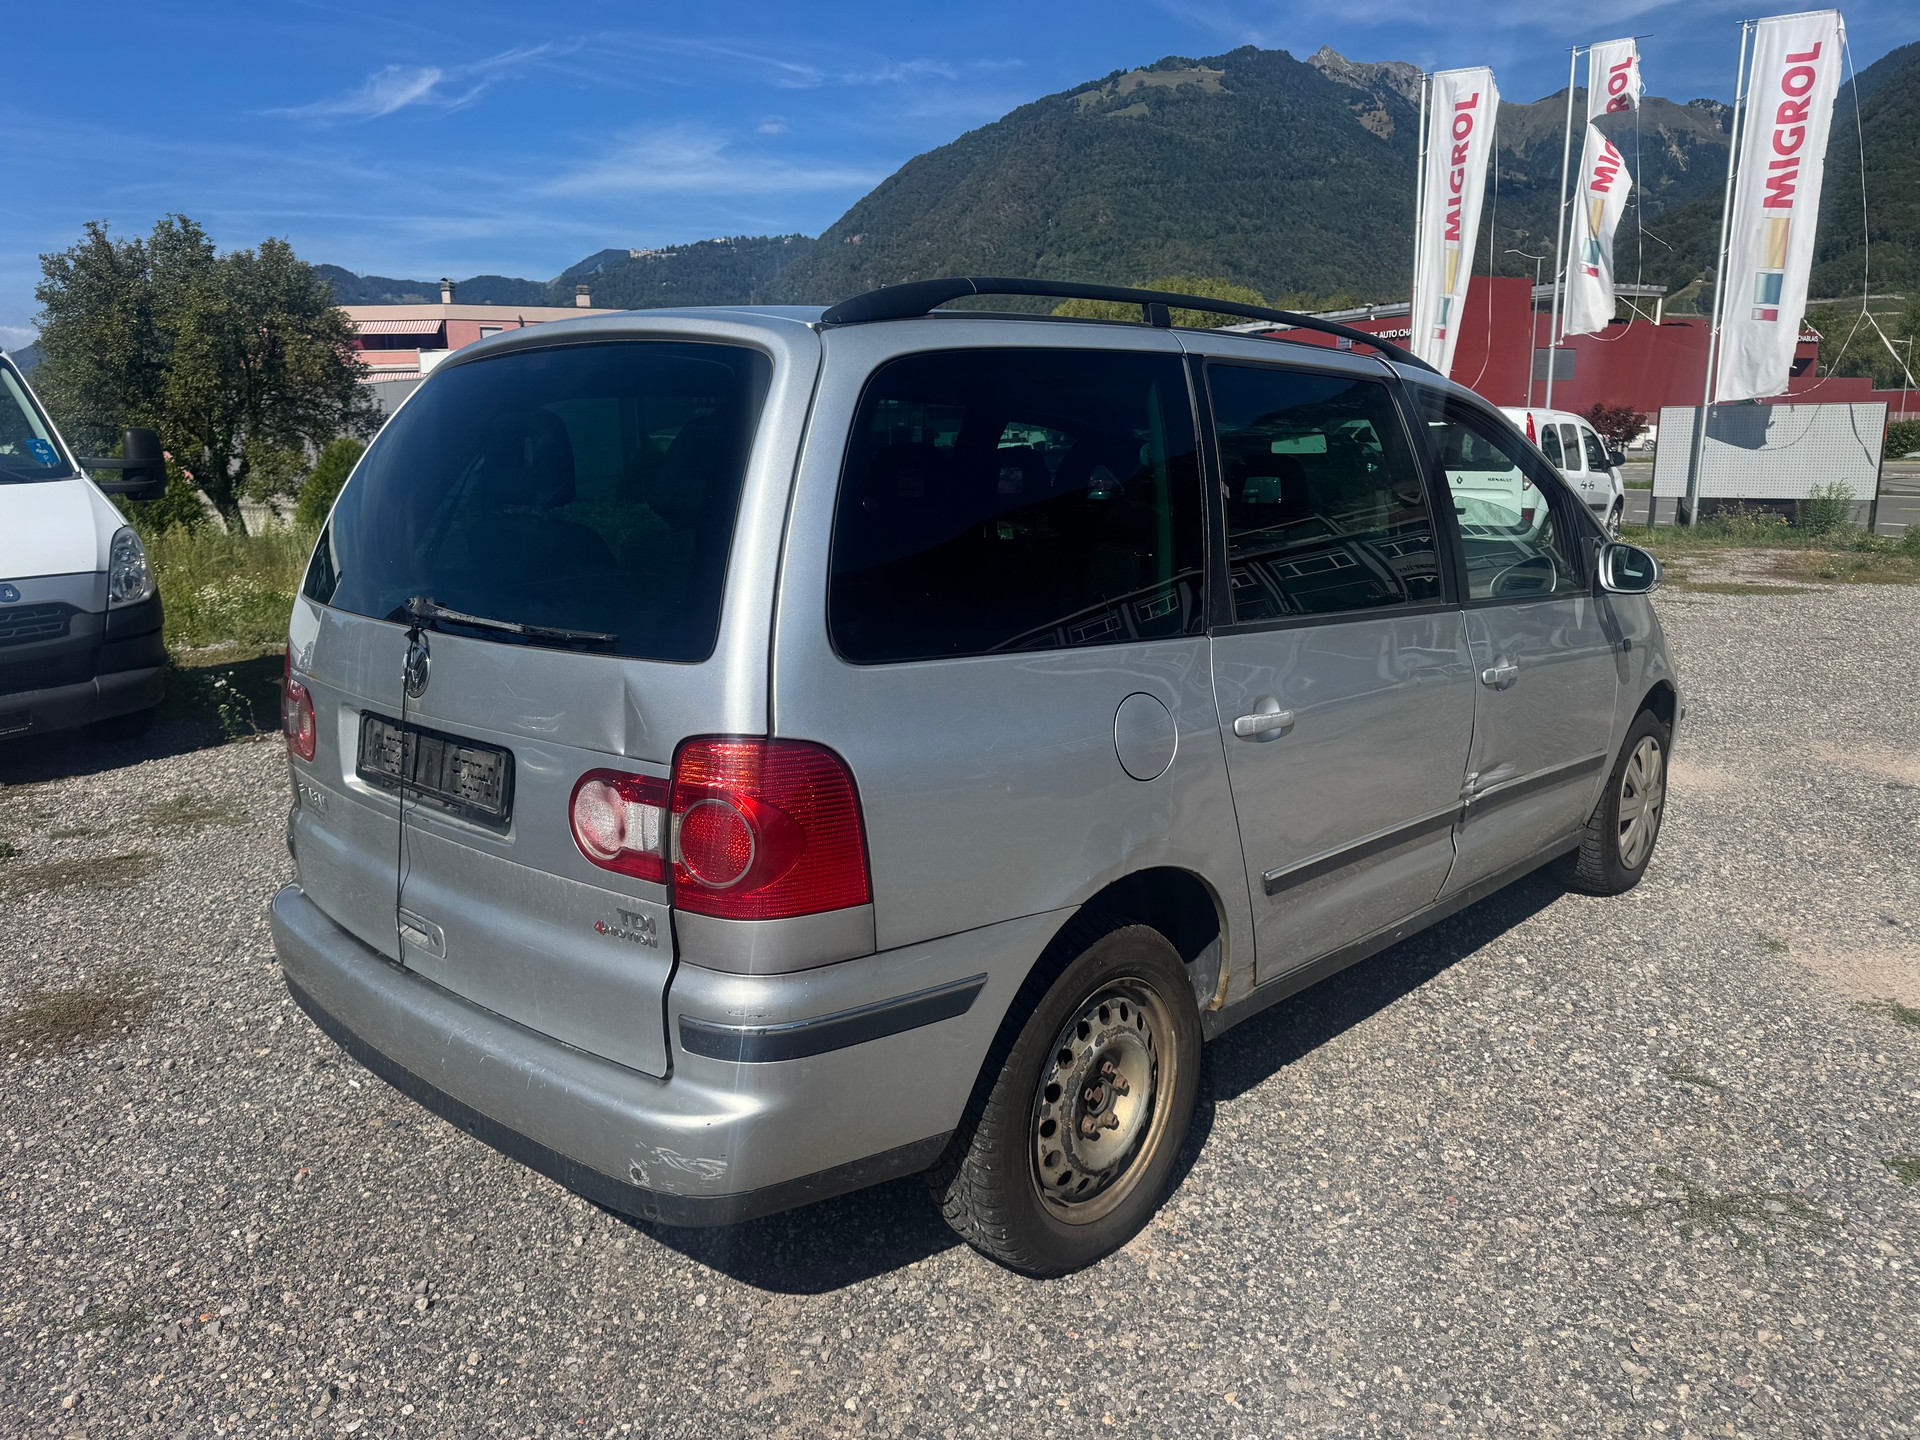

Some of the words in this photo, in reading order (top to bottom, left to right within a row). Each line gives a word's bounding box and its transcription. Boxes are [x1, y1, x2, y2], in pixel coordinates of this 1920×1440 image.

[1444, 91, 1479, 241] MIGROL
[1762, 40, 1822, 209] MIGROL
[1378, 329, 1398, 339] AUTO
[616, 907, 657, 936] TDI
